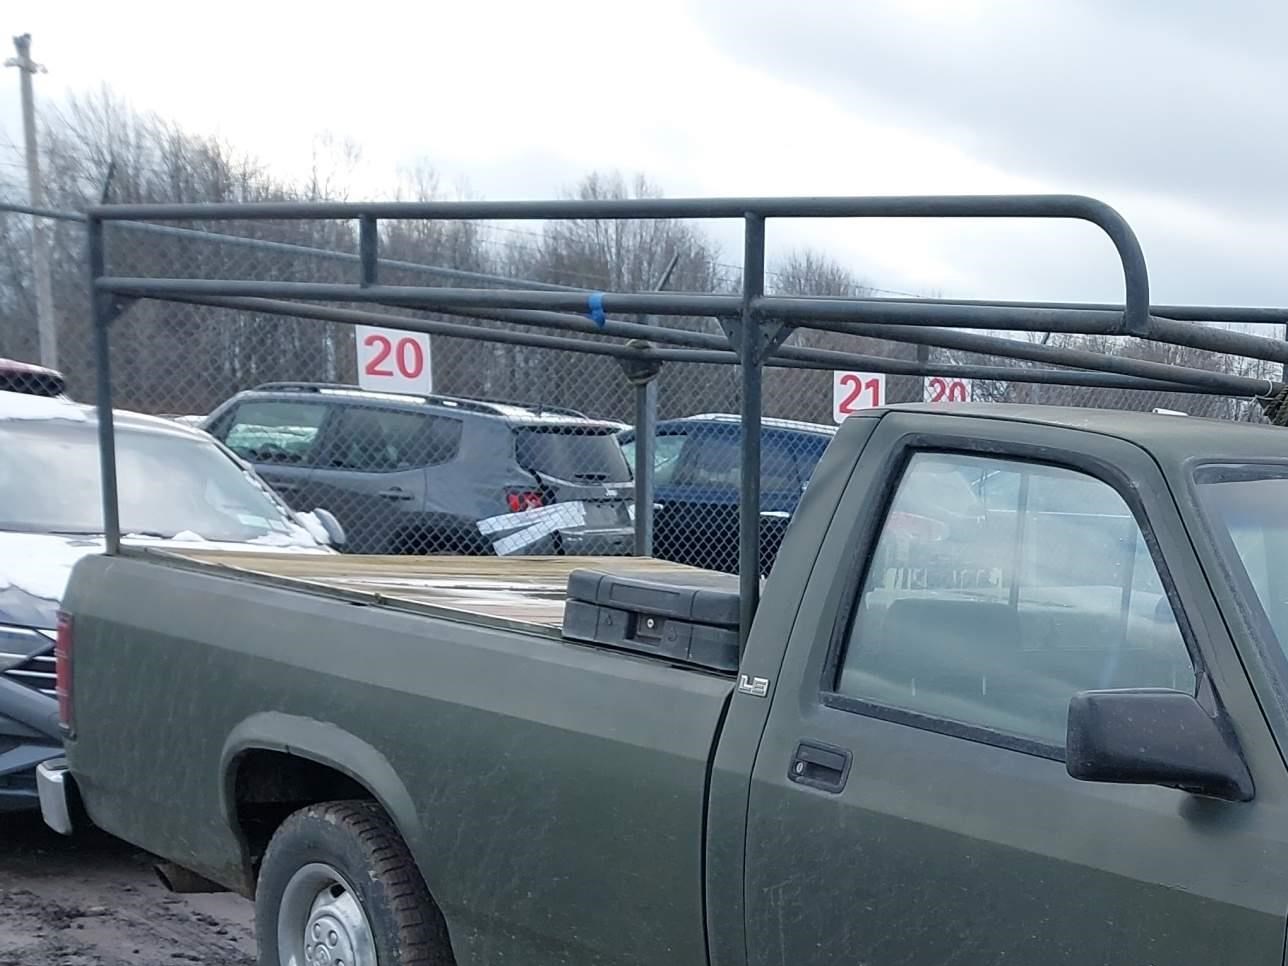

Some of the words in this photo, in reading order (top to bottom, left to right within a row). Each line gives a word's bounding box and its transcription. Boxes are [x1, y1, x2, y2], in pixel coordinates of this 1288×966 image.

[364, 334, 424, 379] 20
[839, 374, 880, 414] 21
[928, 377, 967, 403] 20
